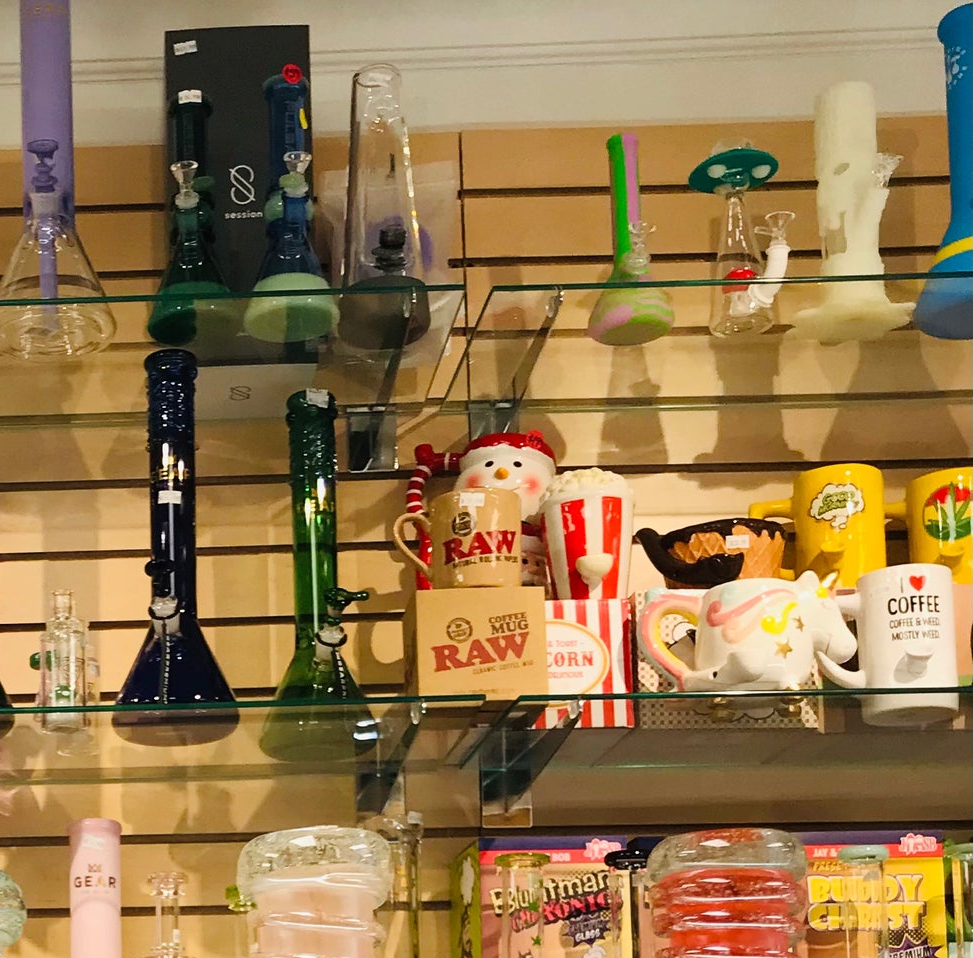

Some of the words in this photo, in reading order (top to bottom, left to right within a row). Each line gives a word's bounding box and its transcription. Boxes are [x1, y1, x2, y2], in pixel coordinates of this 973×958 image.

[224, 210, 263, 219] session
[443, 530, 516, 566] RAW
[900, 576, 904, 593] I
[887, 595, 940, 615] COFFEE
[488, 612, 527, 625] COFFEE
[889, 617, 913, 629] COFFEE
[915, 617, 921, 626] &
[490, 620, 530, 635] MUG
[891, 630, 919, 641] MOSTLY
[431, 632, 530, 673] RAW
[813, 847, 827, 858] JAY
[74, 876, 117, 889] GEAR
[807, 874, 924, 904] BUDDY
